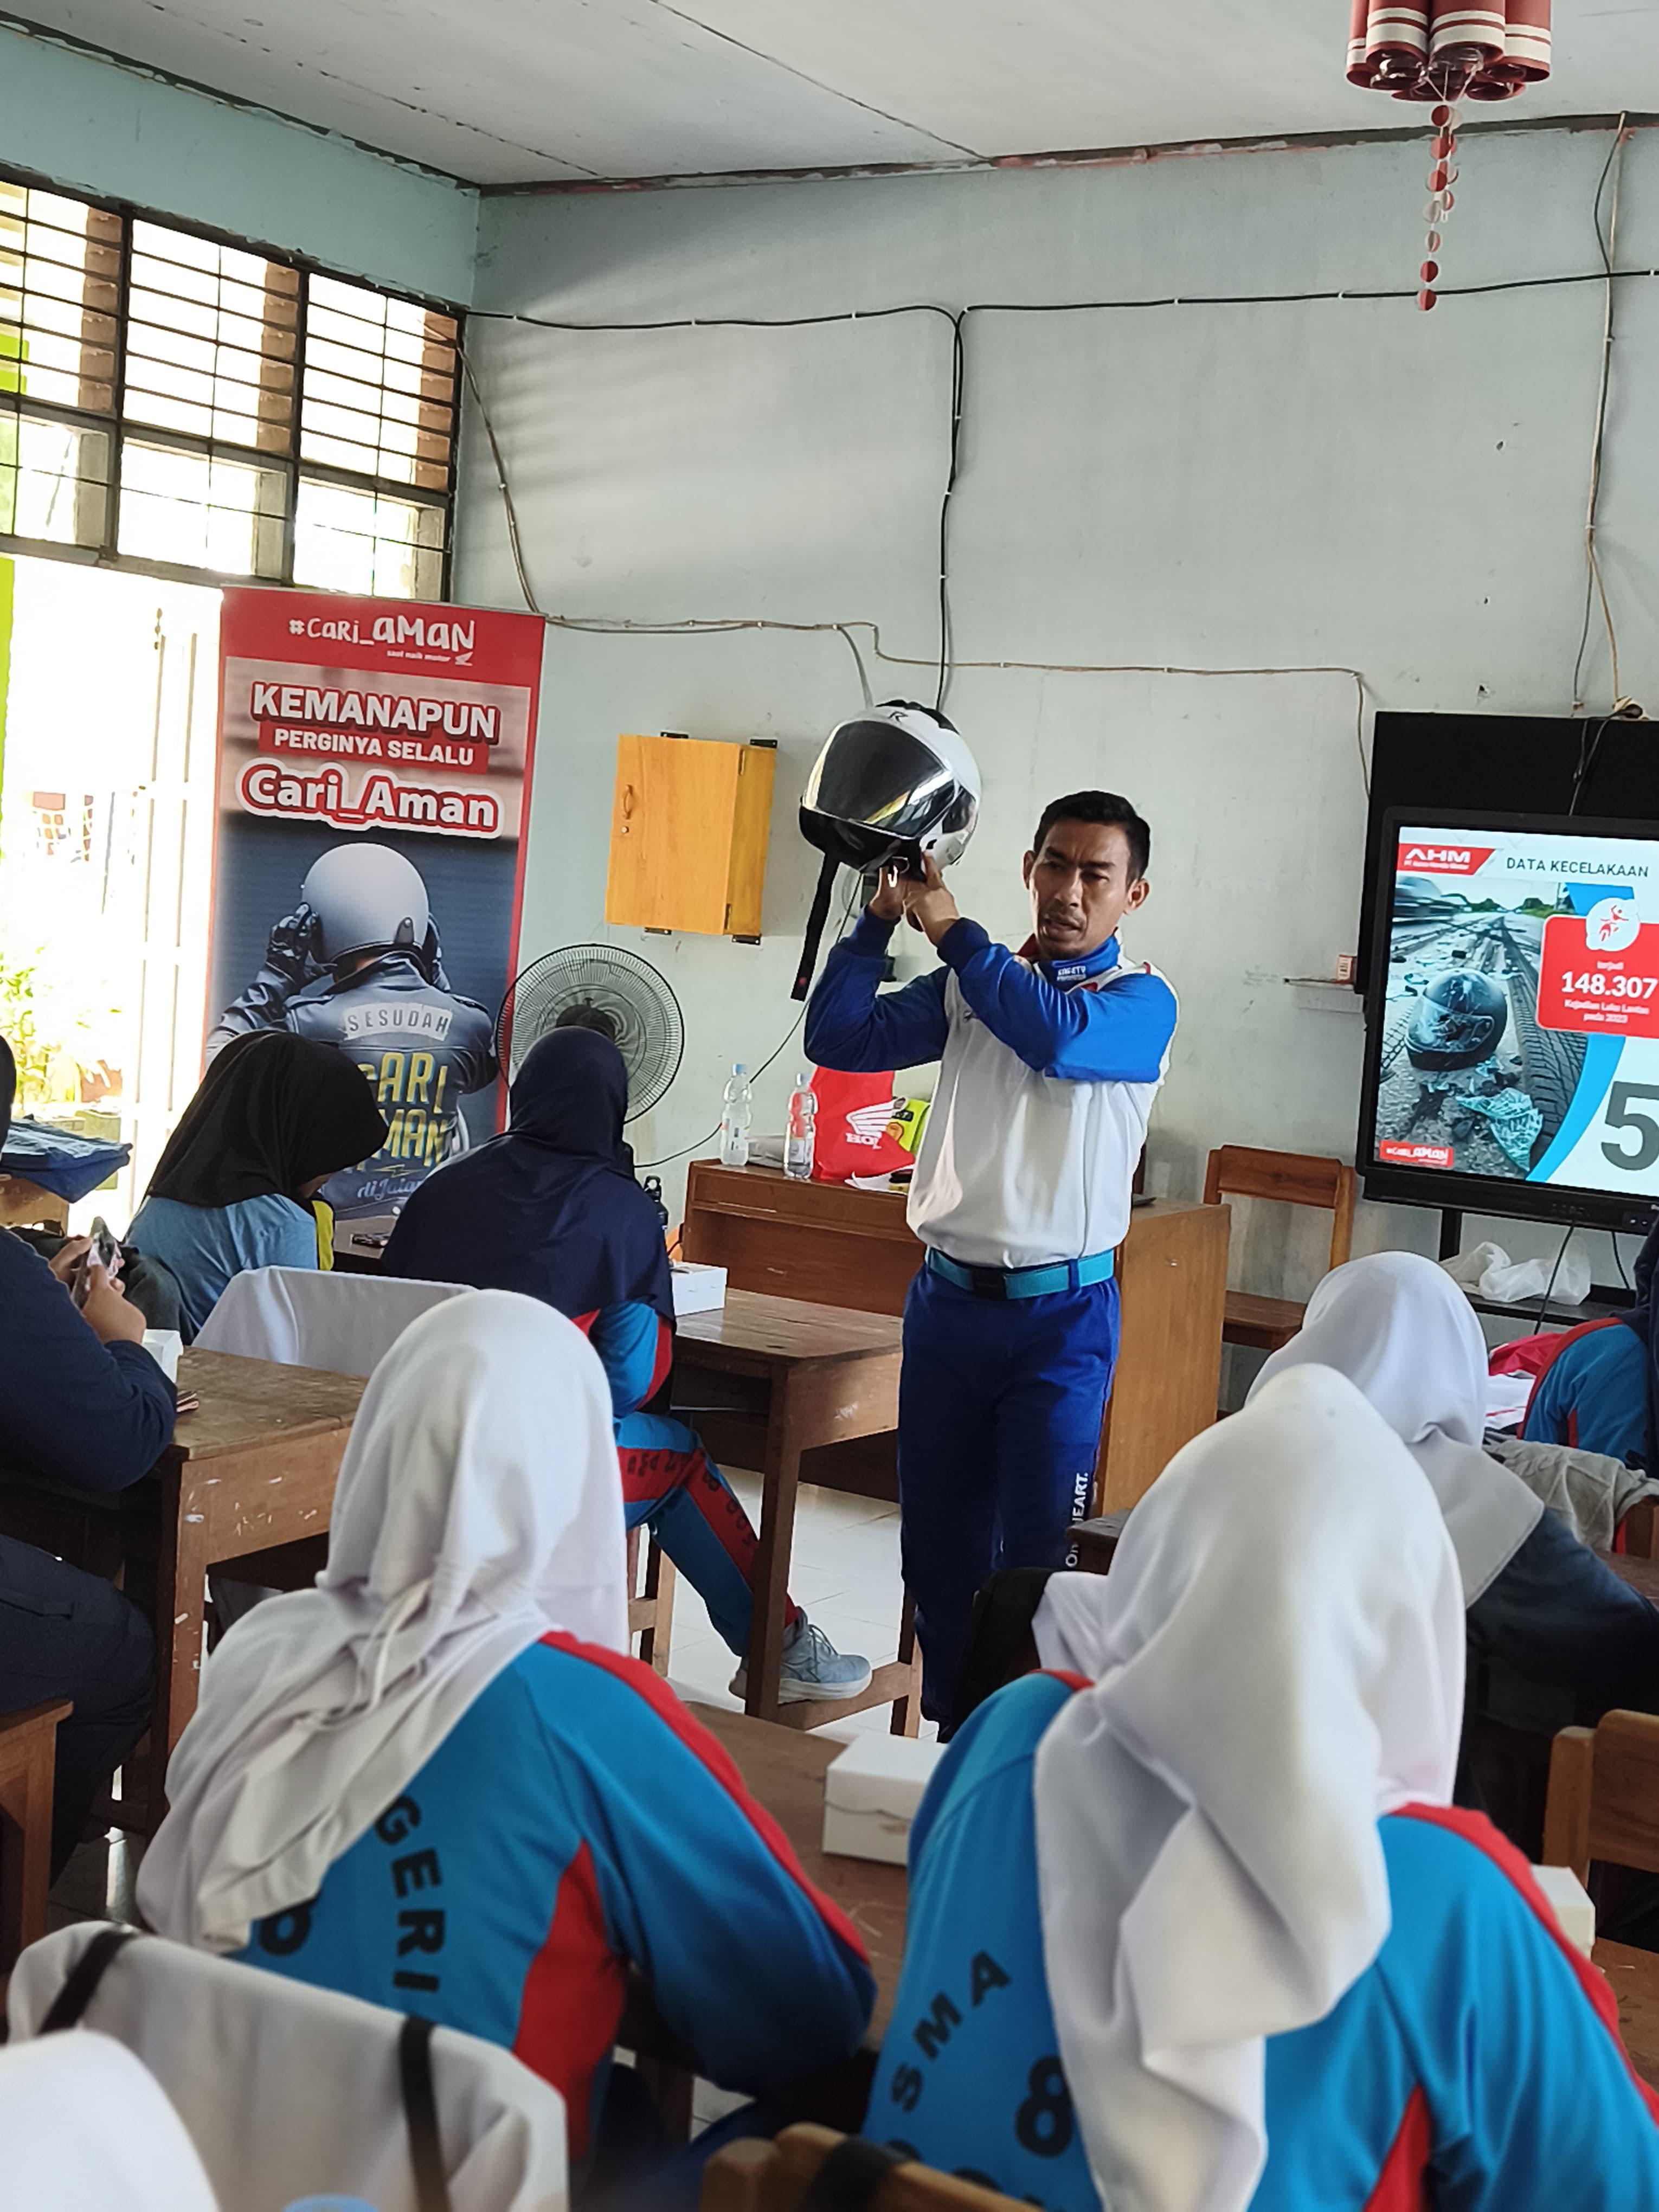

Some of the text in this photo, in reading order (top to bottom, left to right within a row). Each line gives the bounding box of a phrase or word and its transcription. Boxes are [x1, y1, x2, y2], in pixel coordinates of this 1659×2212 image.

[253, 684, 496, 738] KEMANAPUN
[274, 729, 474, 766] PERGINYA SELALU
[248, 769, 494, 827] Cari_Aman
[1405, 848, 1471, 864] AHM
[1507, 857, 1649, 877] DATA KECELAKAAN
[1561, 971, 1658, 999] 148.307
[348, 1008, 449, 1033] SESUDAH
[891, 1950, 1011, 2113] SMA
[1015, 2055, 1073, 2158] 8
